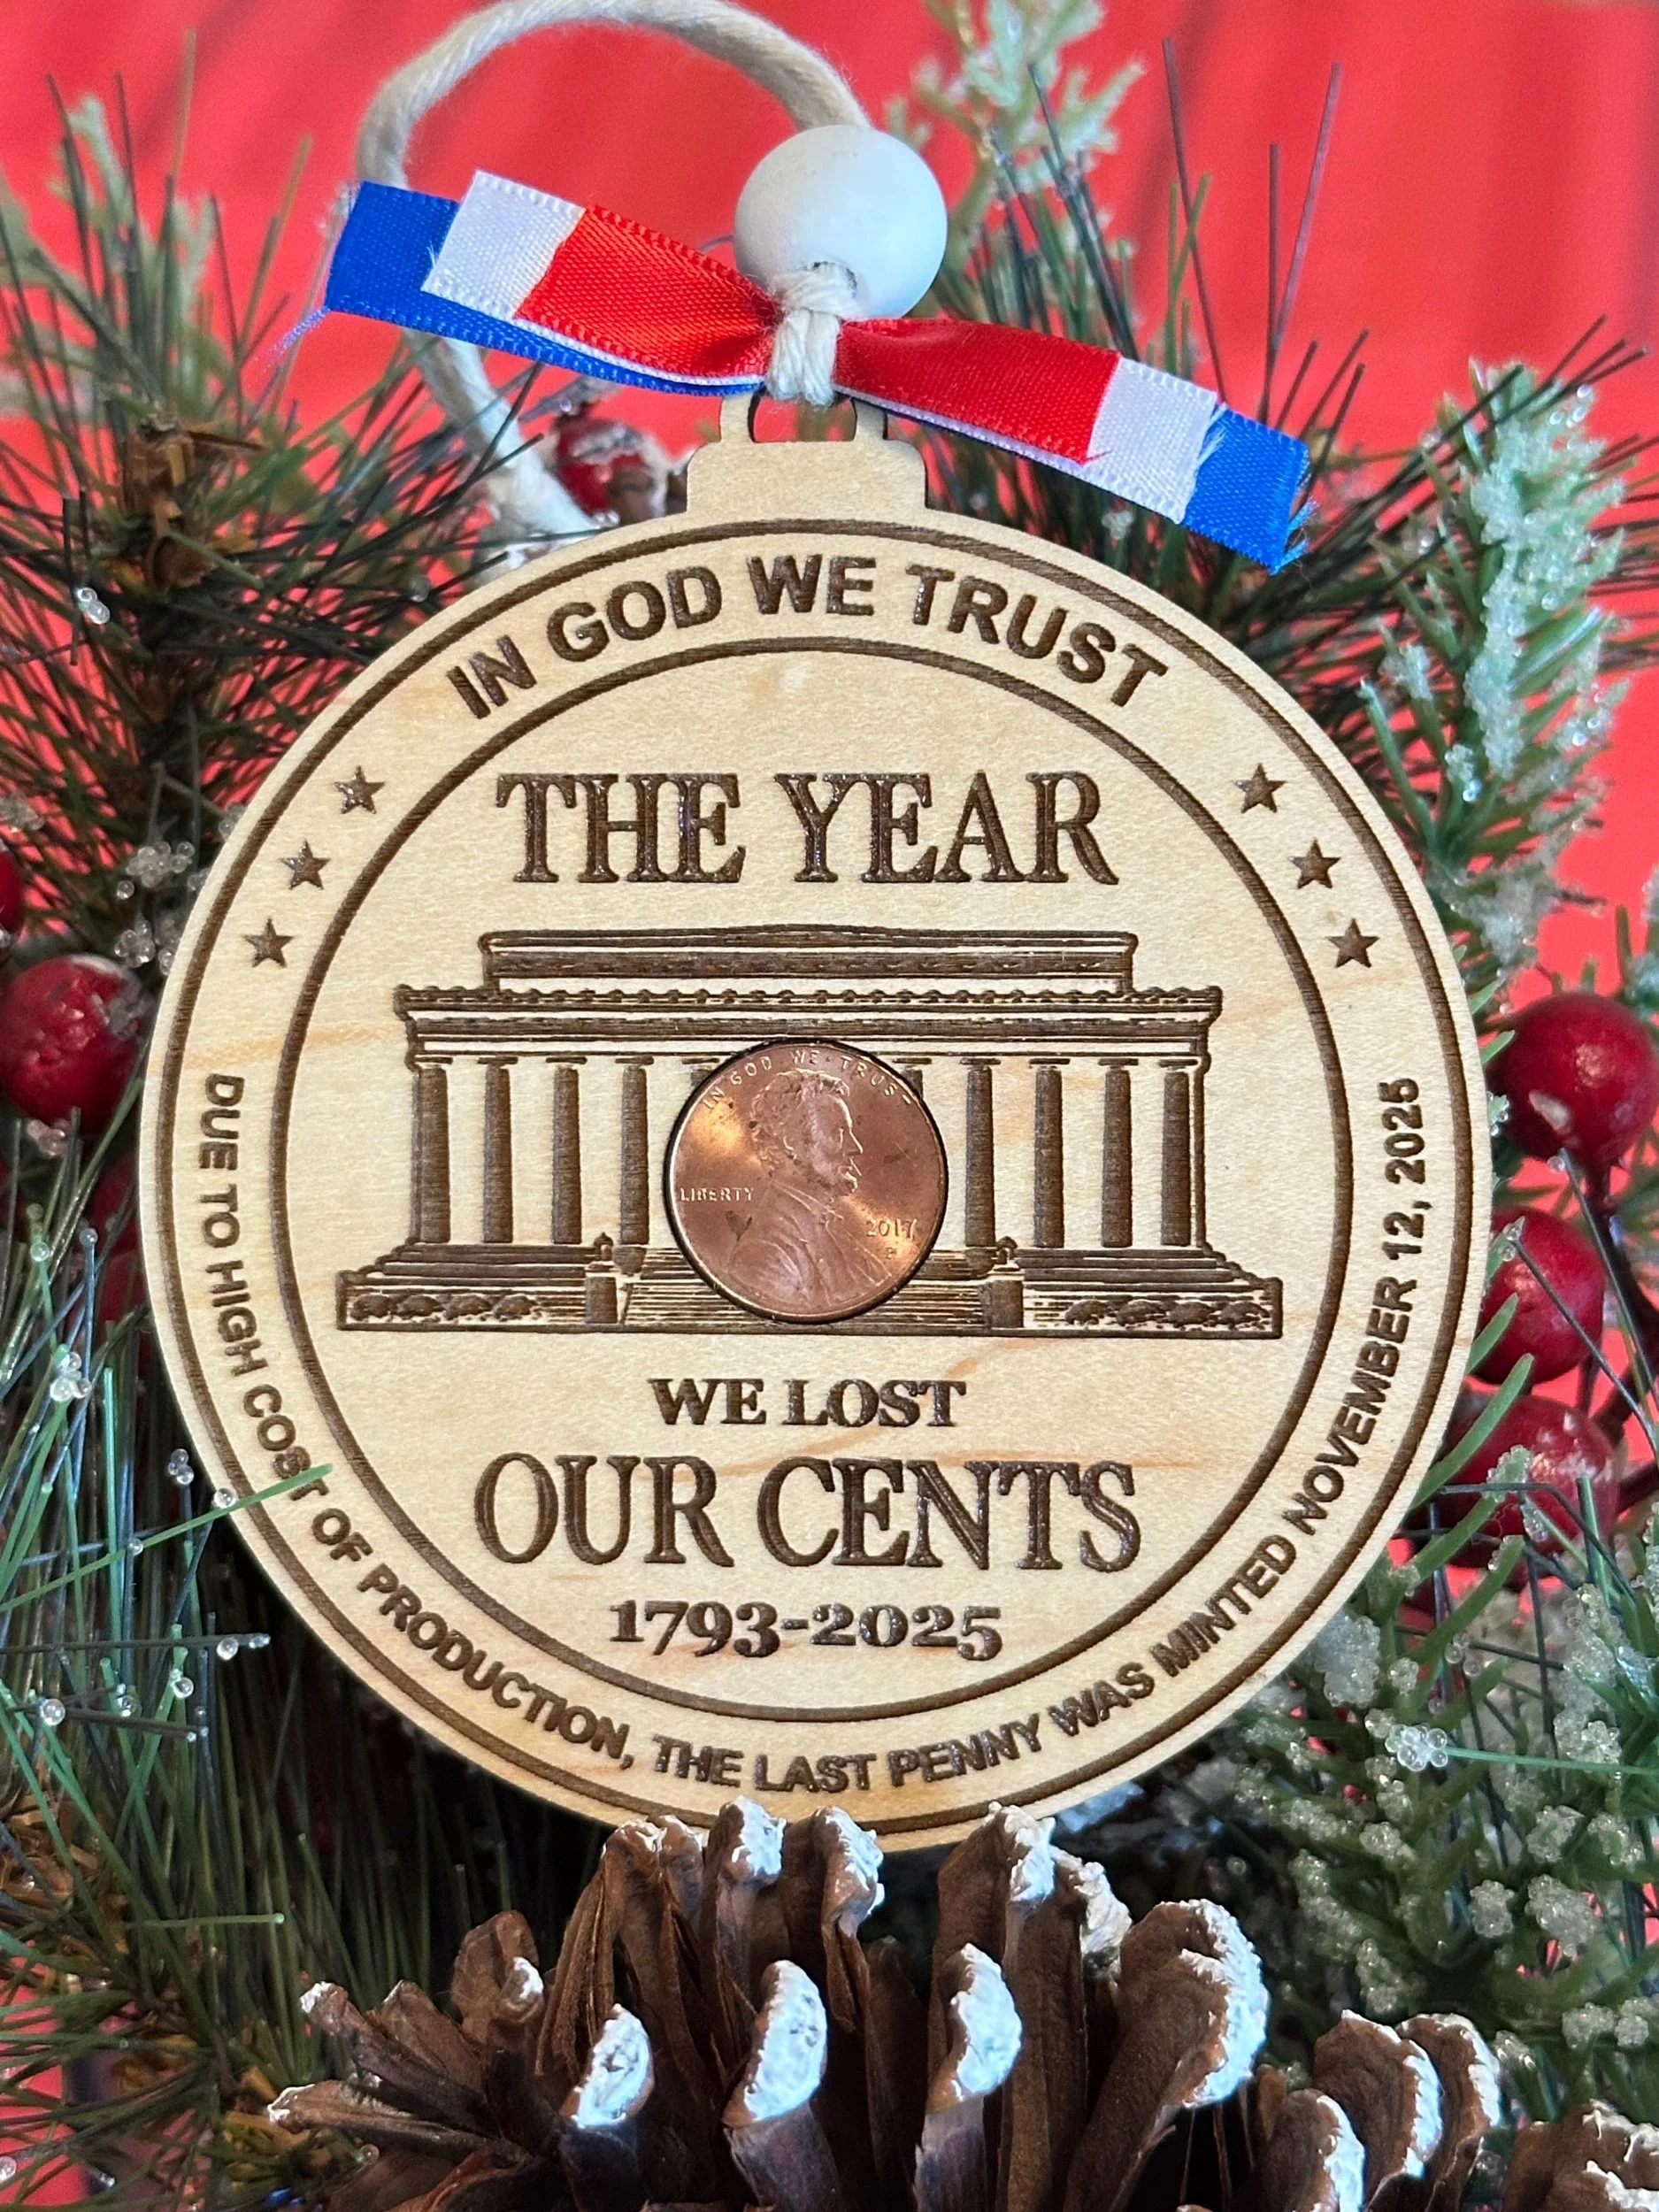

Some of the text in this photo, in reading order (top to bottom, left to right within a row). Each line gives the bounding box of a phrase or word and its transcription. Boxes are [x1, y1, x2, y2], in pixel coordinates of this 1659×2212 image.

[446, 554, 1168, 718] IN GOD WE TRUST
[496, 772, 1118, 885] THE YEAR
[702, 1087, 726, 1110] IN
[730, 1056, 772, 1086] GOD
[792, 1048, 820, 1064] WE
[680, 1187, 754, 1202] LIBERTY
[866, 1217, 918, 1240] 2017
[199, 1073, 1432, 1793] DUE TO HIGH COST OF PRODUCTION, THE LAST PENNY WAS MINTED NOVEMBER 12, 2025
[649, 1378, 967, 1427] WE LOST
[474, 1453, 1141, 1573] OUR CENTS
[611, 1600, 1002, 1661] 1793-2025
